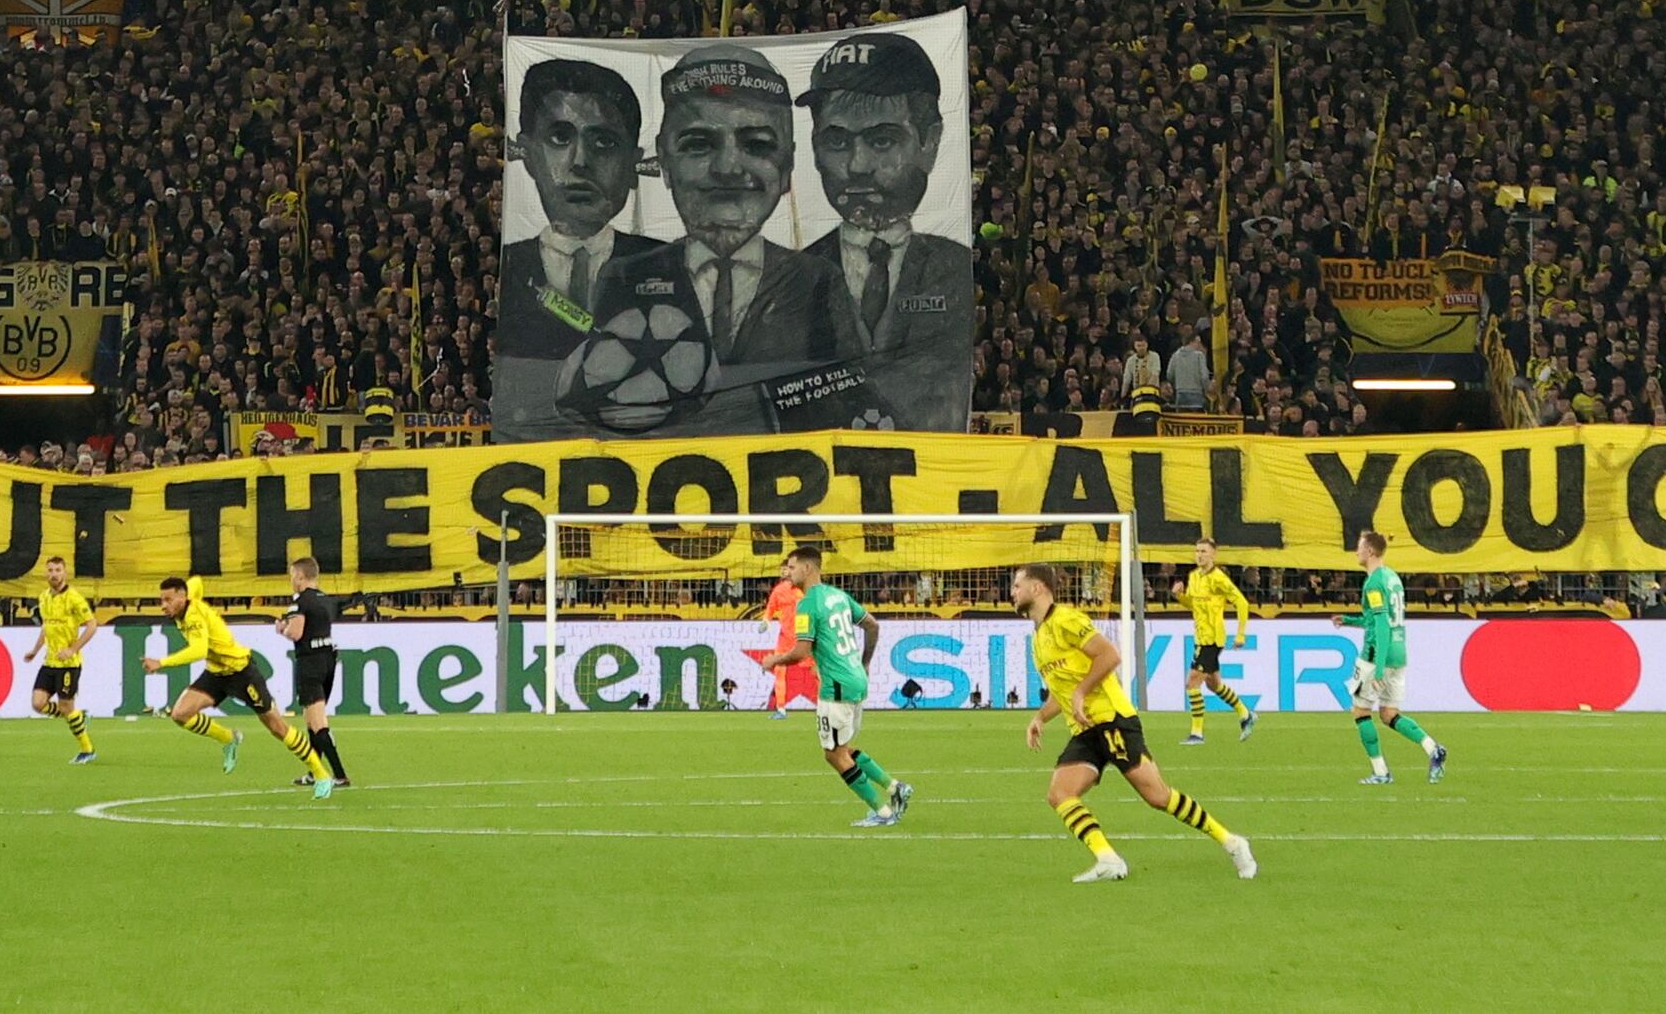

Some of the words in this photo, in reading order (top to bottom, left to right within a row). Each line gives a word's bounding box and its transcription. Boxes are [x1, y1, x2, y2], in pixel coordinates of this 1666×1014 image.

[710, 63, 747, 76] RULES
[739, 76, 785, 94] AROUND
[1325, 263, 1352, 279] NO
[3, 315, 58, 358] BVB
[16, 357, 41, 373] 09
[776, 381, 805, 397] HOW
[805, 375, 823, 388] TO
[826, 368, 851, 382] KILL
[776, 396, 802, 410] THE
[167, 467, 432, 577] THE
[471, 445, 917, 567] SPORT
[1032, 445, 1283, 550] ALL
[1306, 444, 1586, 553] YOU
[828, 609, 859, 657] 39
[113, 623, 726, 716] Hneken
[1103, 728, 1124, 754] 14
